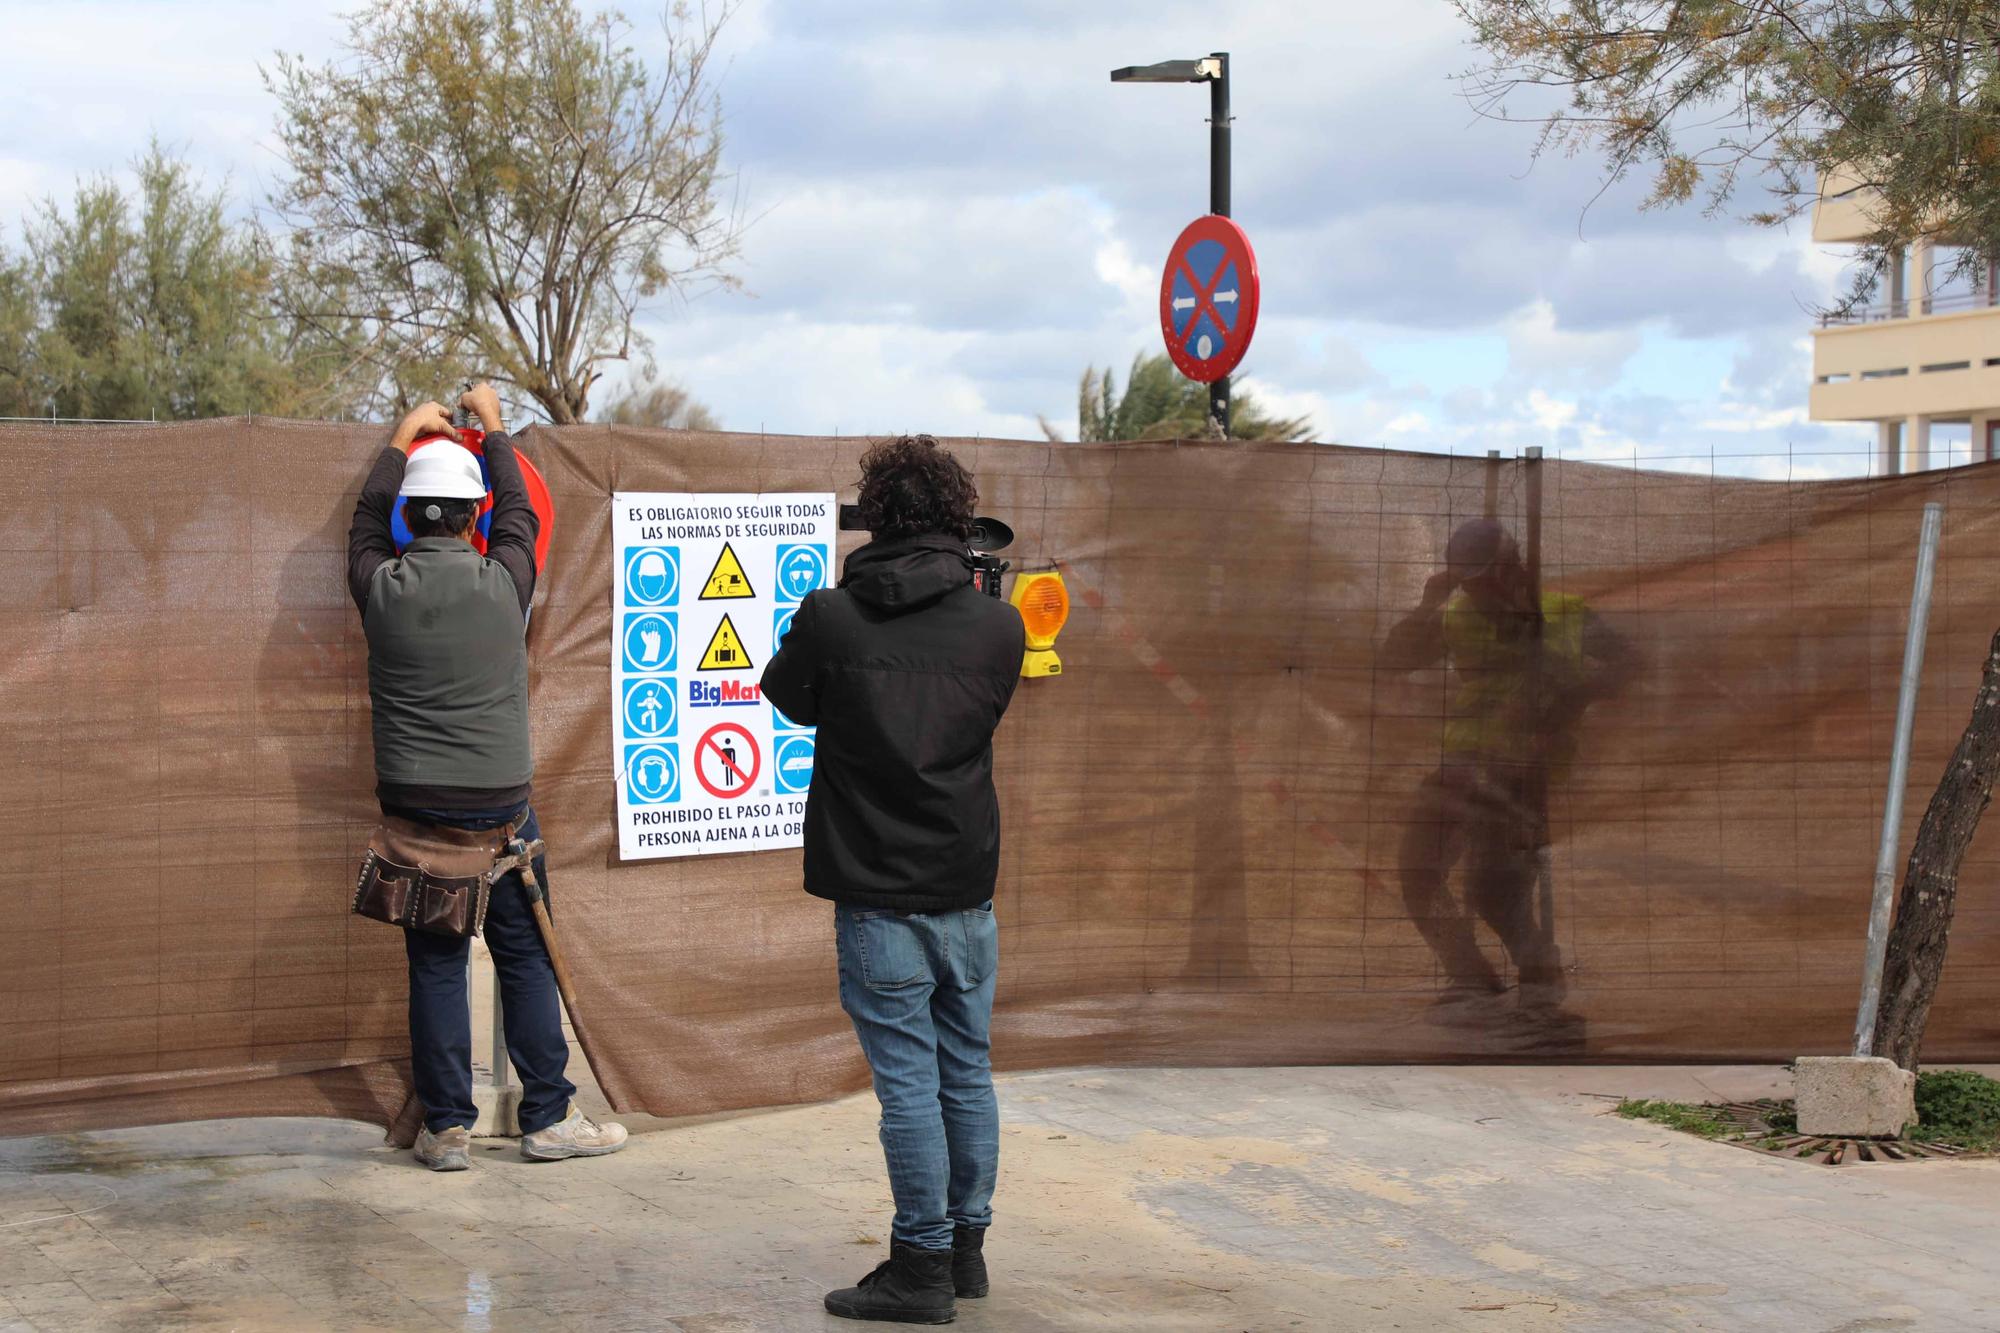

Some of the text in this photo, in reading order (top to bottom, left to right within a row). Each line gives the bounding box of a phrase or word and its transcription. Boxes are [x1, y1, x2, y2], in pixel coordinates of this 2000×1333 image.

[629, 504, 825, 521] ES OBLIGATORIO SEGUIR TODAS
[642, 523, 815, 539] LAS NORMAS DE SEGURIDAD
[690, 680, 760, 706] BigMat
[634, 801, 808, 825] PROHIBIDO EL PASO A TO
[638, 822, 805, 846] PERSONA AJENA A LA OB
